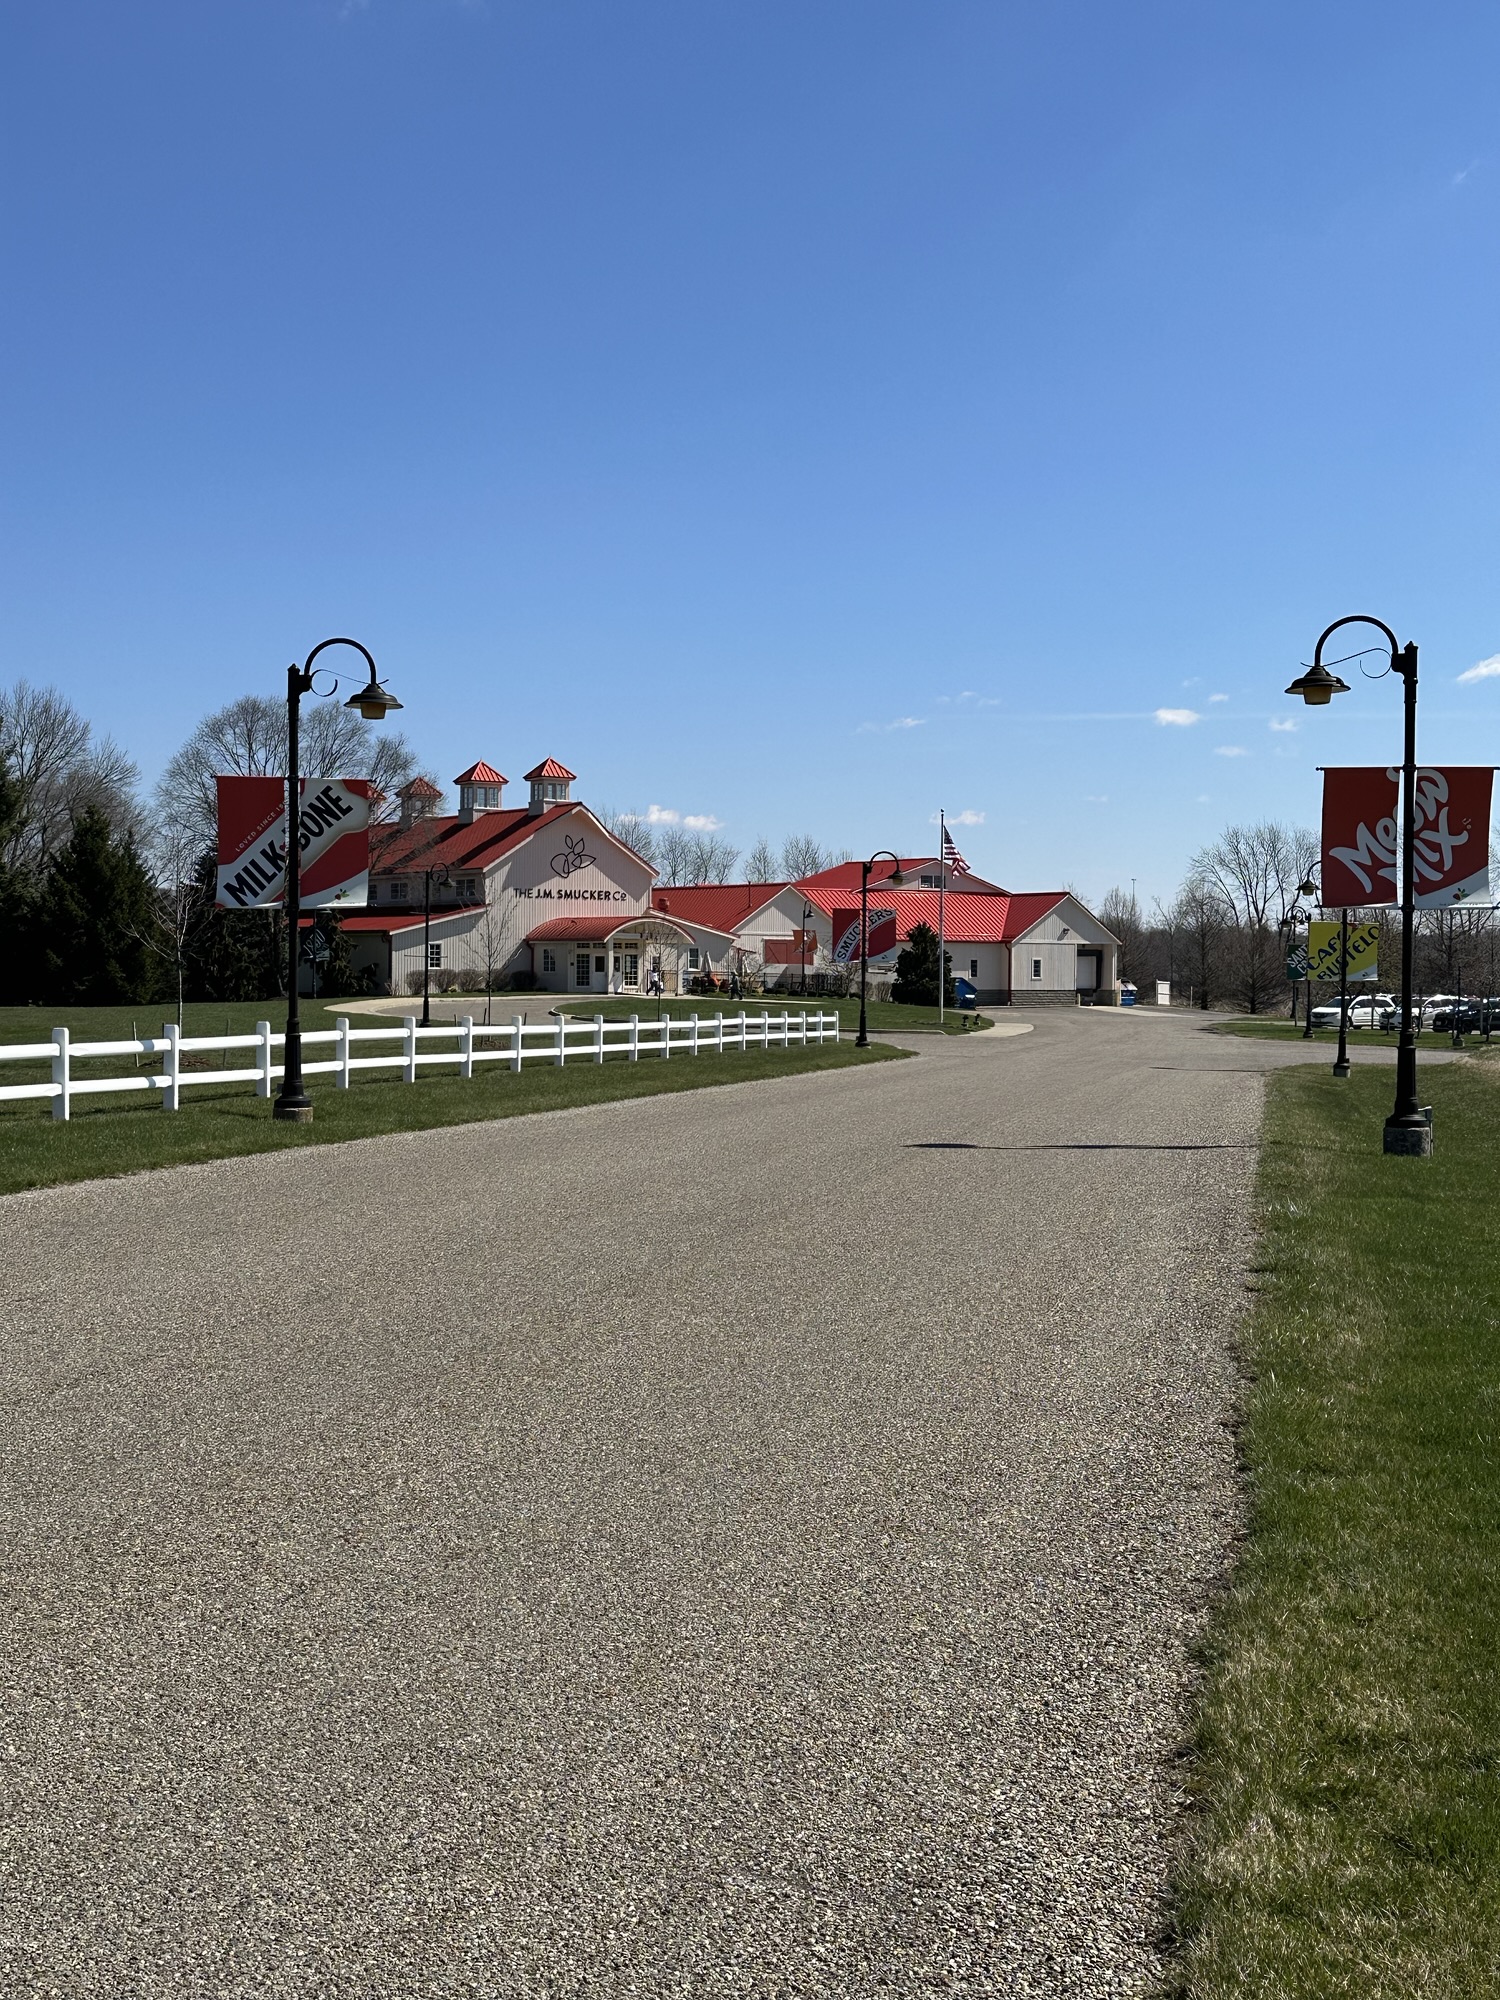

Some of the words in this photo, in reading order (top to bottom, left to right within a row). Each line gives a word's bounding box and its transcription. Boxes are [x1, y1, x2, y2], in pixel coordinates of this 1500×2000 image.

[235, 831, 256, 852] LOVED
[256, 811, 276, 832] SINCE
[513, 888, 533, 899] THE
[535, 889, 555, 900] J.M.
[556, 889, 611, 901] SMUCKER
